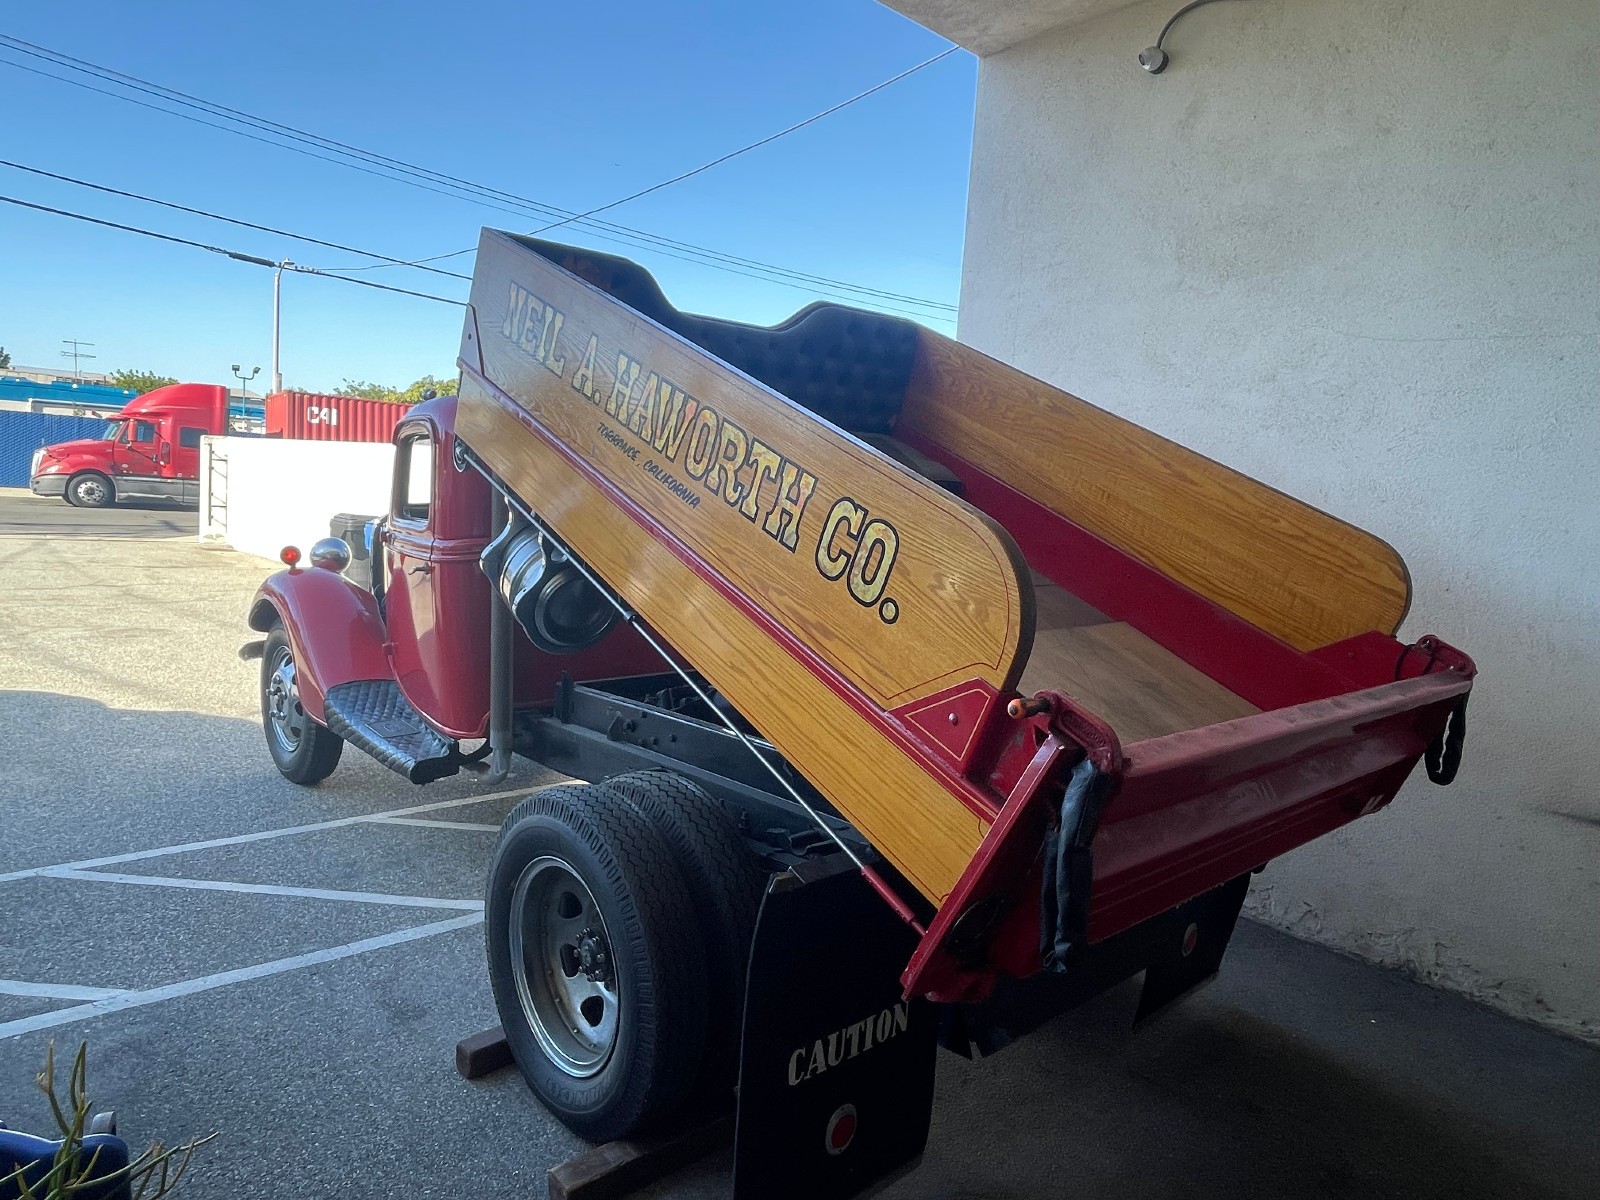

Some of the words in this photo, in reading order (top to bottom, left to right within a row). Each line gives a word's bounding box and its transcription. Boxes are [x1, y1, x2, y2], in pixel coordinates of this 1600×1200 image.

[308, 406, 337, 425] CAI
[502, 281, 566, 379] NEIL
[571, 331, 602, 406] A.
[604, 351, 818, 553] HAWORTH
[815, 496, 899, 624] CO.
[643, 459, 701, 509] CALIFORNIA
[788, 1001, 909, 1086] CAUTION
